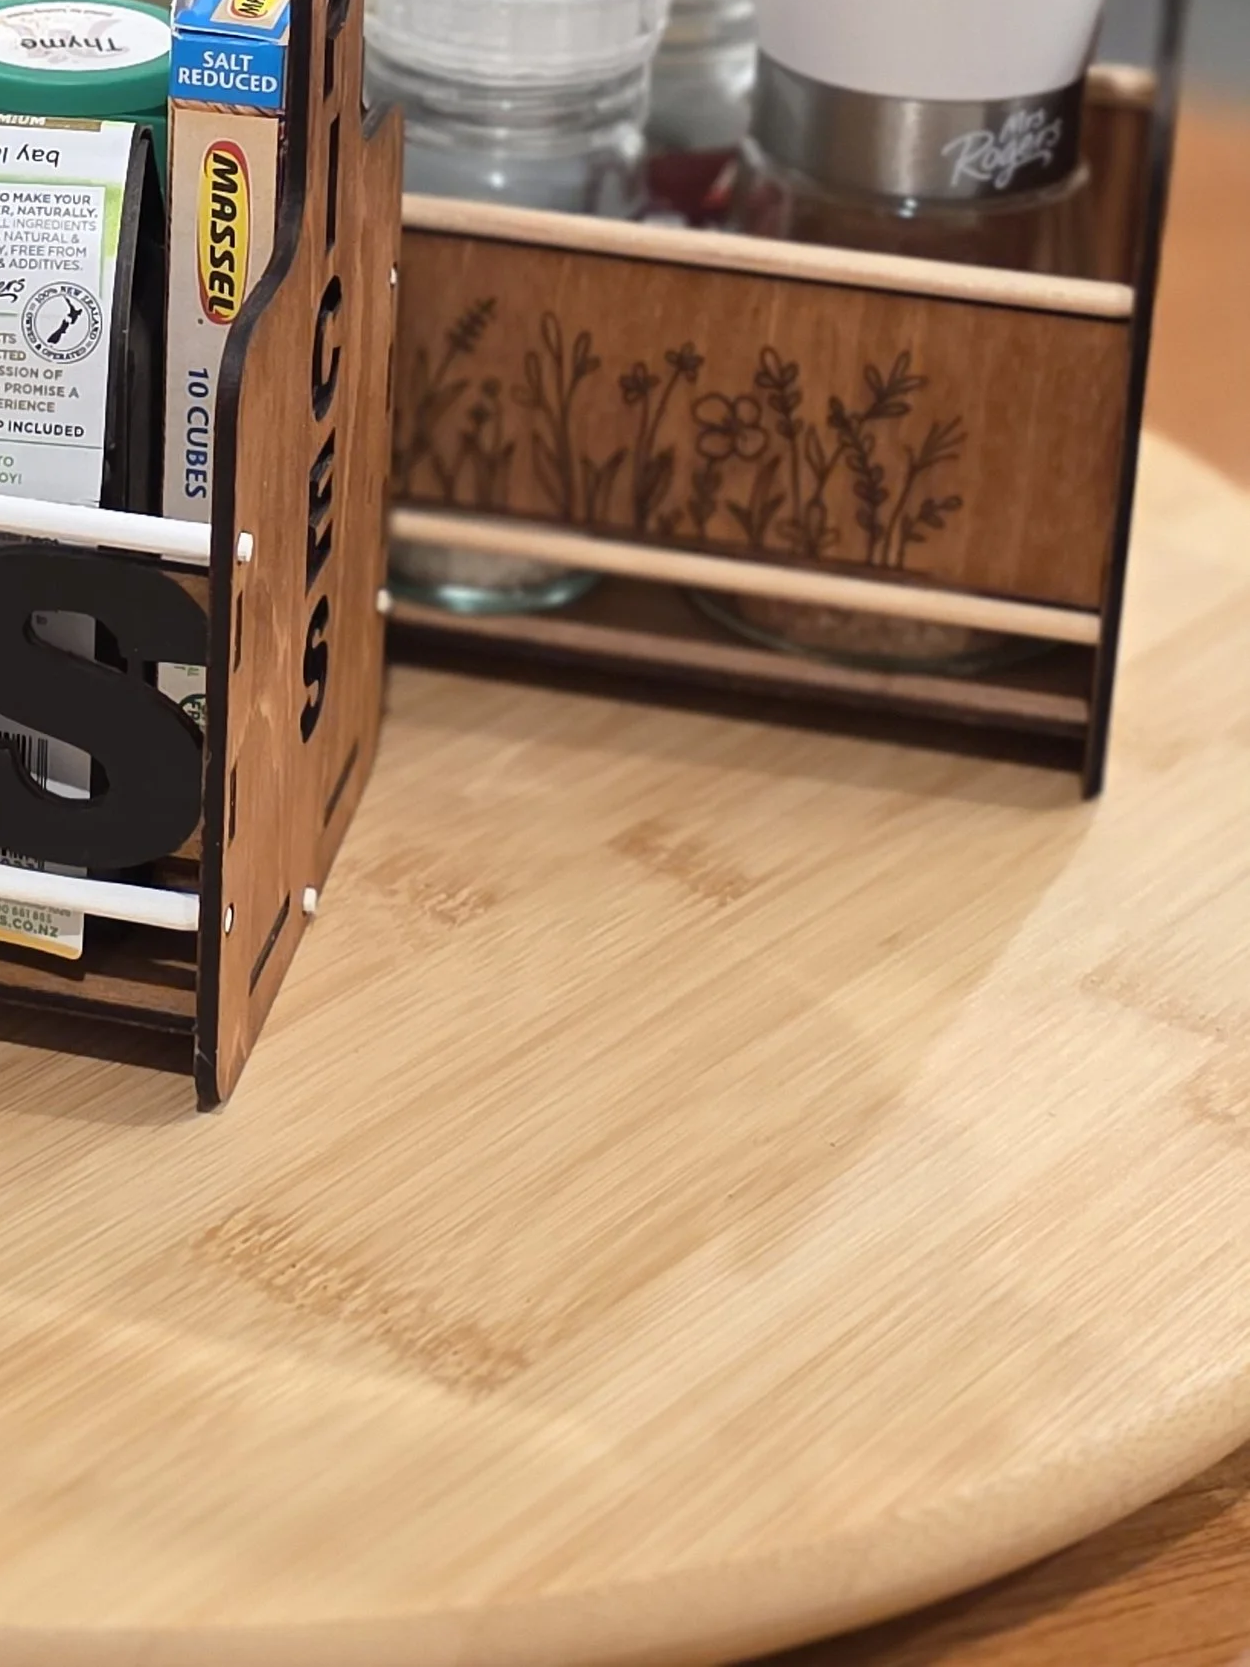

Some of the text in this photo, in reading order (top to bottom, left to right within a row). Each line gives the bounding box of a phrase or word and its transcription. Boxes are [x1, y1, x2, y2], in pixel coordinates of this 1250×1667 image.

[21, 36, 122, 52] Thyme
[203, 51, 253, 71] SALT
[178, 67, 278, 93] REDUCED
[999, 107, 1046, 143] Mrs
[17, 144, 59, 167] bay
[941, 117, 1063, 190] Rogers
[13, 193, 50, 203] MAKE
[54, 194, 90, 205] YOUR
[17, 206, 97, 218] NATURALLY.
[13, 219, 96, 231] INGREDIENTS
[208, 152, 239, 313] MASSEL
[4, 231, 68, 243] NATURAL
[71, 234, 79, 243] &
[11, 245, 44, 256] FREE
[48, 246, 86, 257] FROM
[43, 369, 63, 380] OF
[5, 382, 64, 397] PROMISE
[69, 387, 79, 398] A
[8, 421, 84, 437] INCLUDED
[185, 368, 210, 499] 10 CUBES
